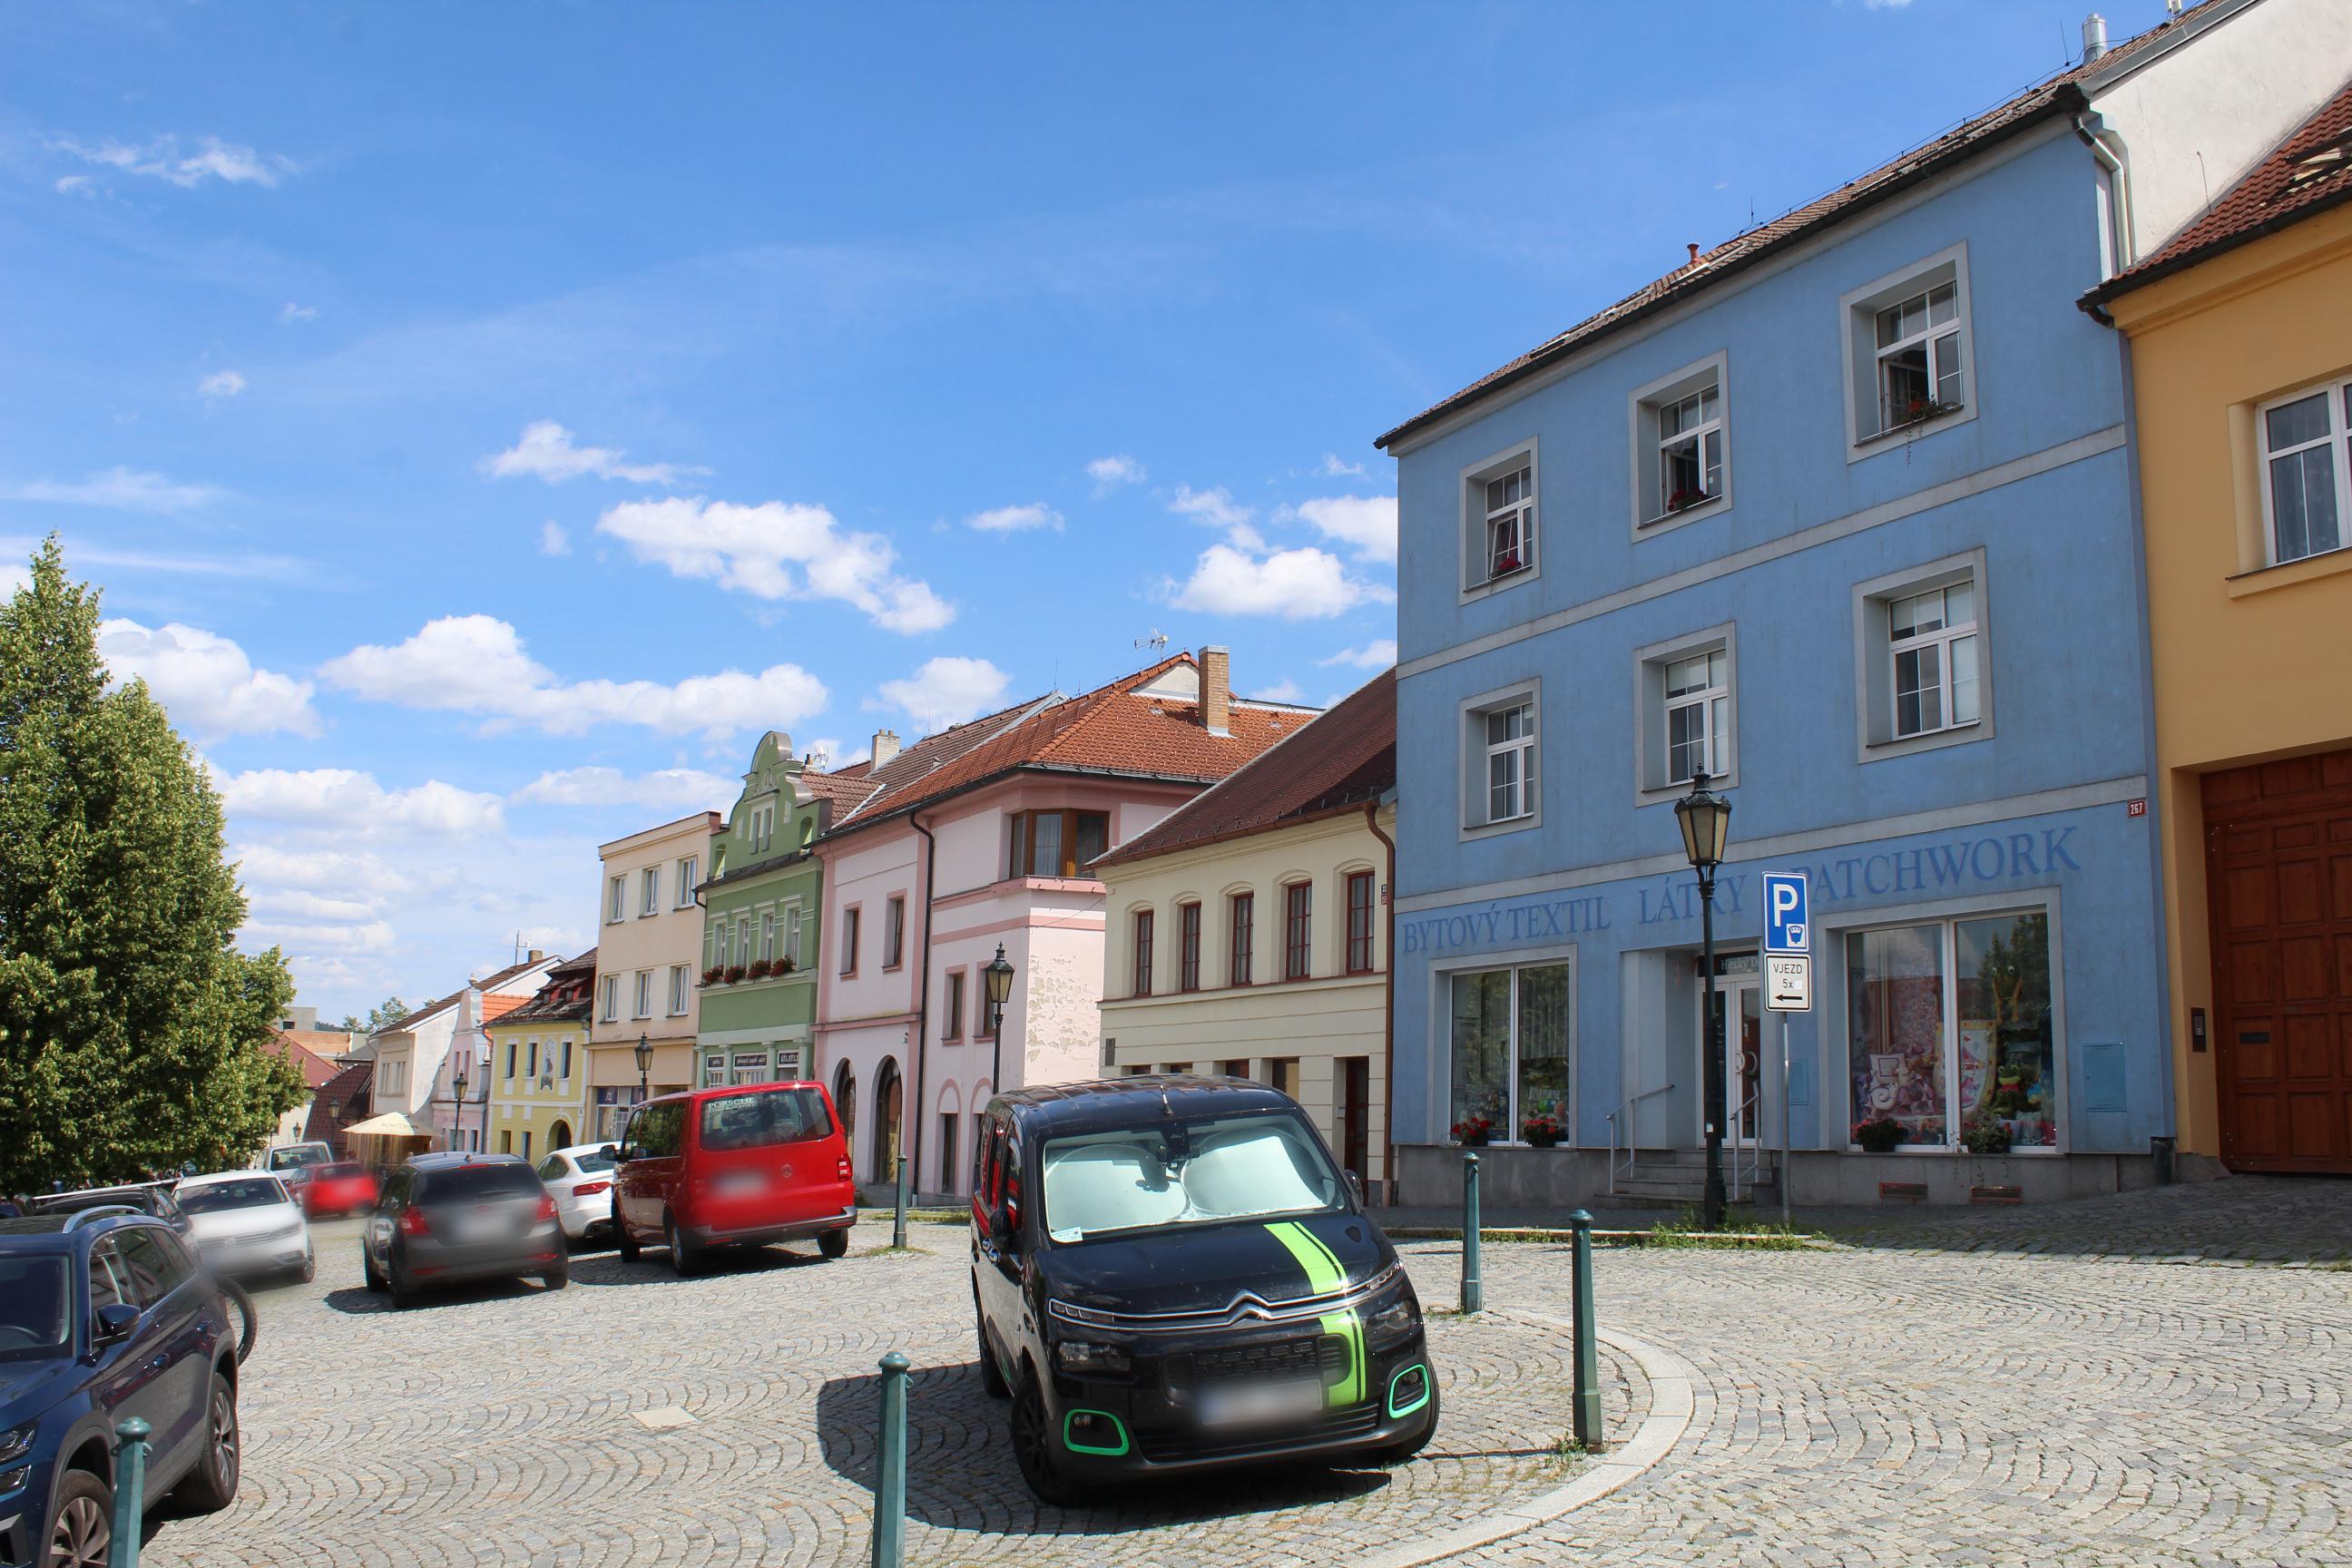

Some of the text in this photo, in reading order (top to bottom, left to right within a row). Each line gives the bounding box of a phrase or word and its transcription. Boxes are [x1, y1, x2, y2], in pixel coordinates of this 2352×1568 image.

[2130, 802, 2142, 815] 267
[1773, 884, 1798, 926] P
[1403, 903, 1500, 953] BYTOVÝ
[1506, 896, 1612, 941] TEXTIL
[1638, 875, 1746, 926] LÁTKY
[1773, 964, 1803, 974] VJEZD
[708, 1097, 755, 1108] PORSCHE
